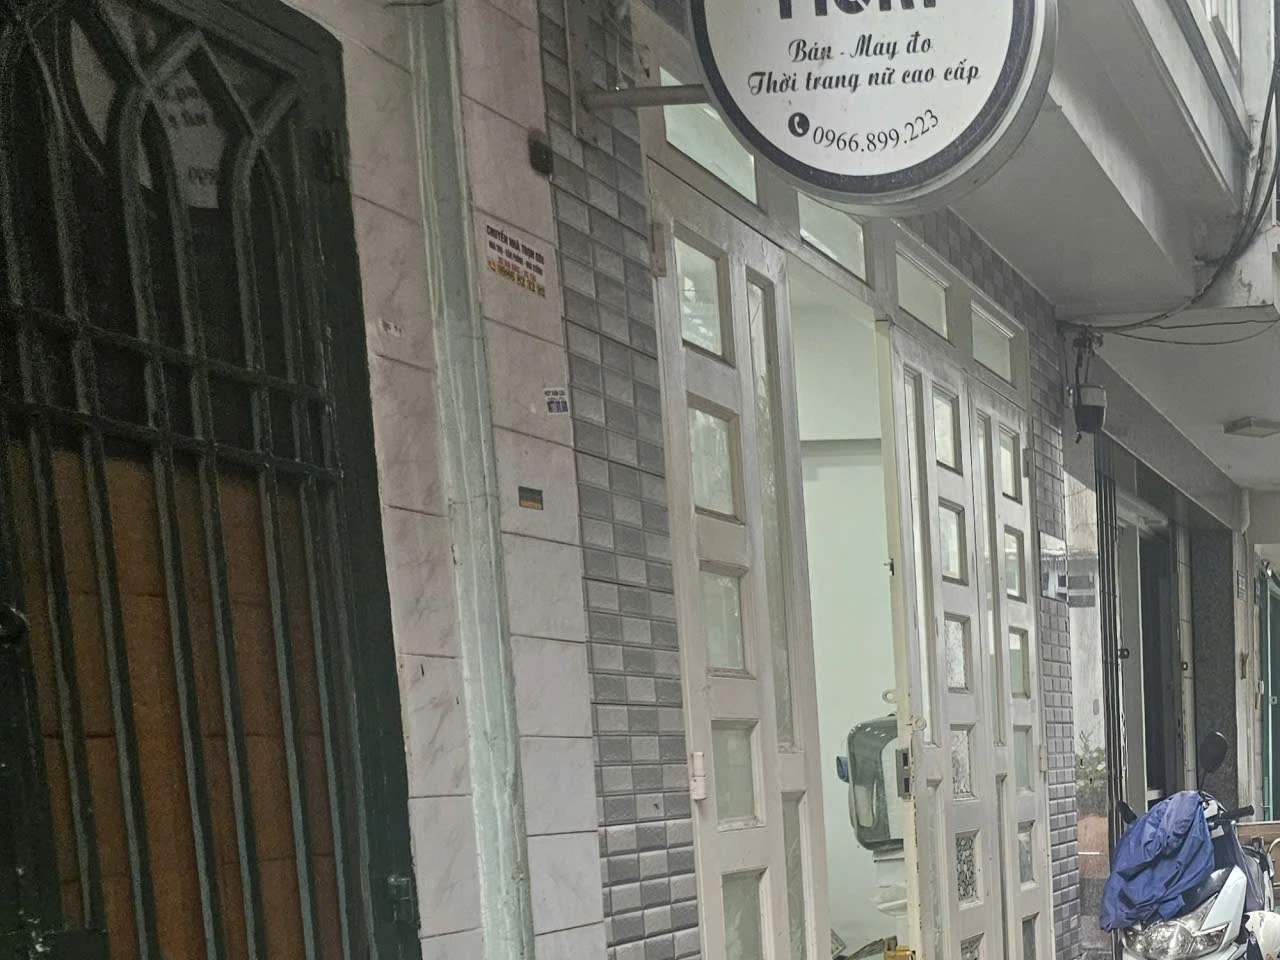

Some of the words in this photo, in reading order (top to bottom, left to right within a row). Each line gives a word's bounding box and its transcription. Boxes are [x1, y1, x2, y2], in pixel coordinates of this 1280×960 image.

[788, 38, 832, 63] Bán
[850, 33, 898, 60] May
[906, 30, 933, 54] đo
[748, 70, 799, 96] Thời
[806, 70, 860, 93] trang
[867, 66, 896, 86] nữ
[902, 66, 936, 83] cao
[943, 58, 980, 86] cấp
[812, 109, 940, 153] 0966.899.223
